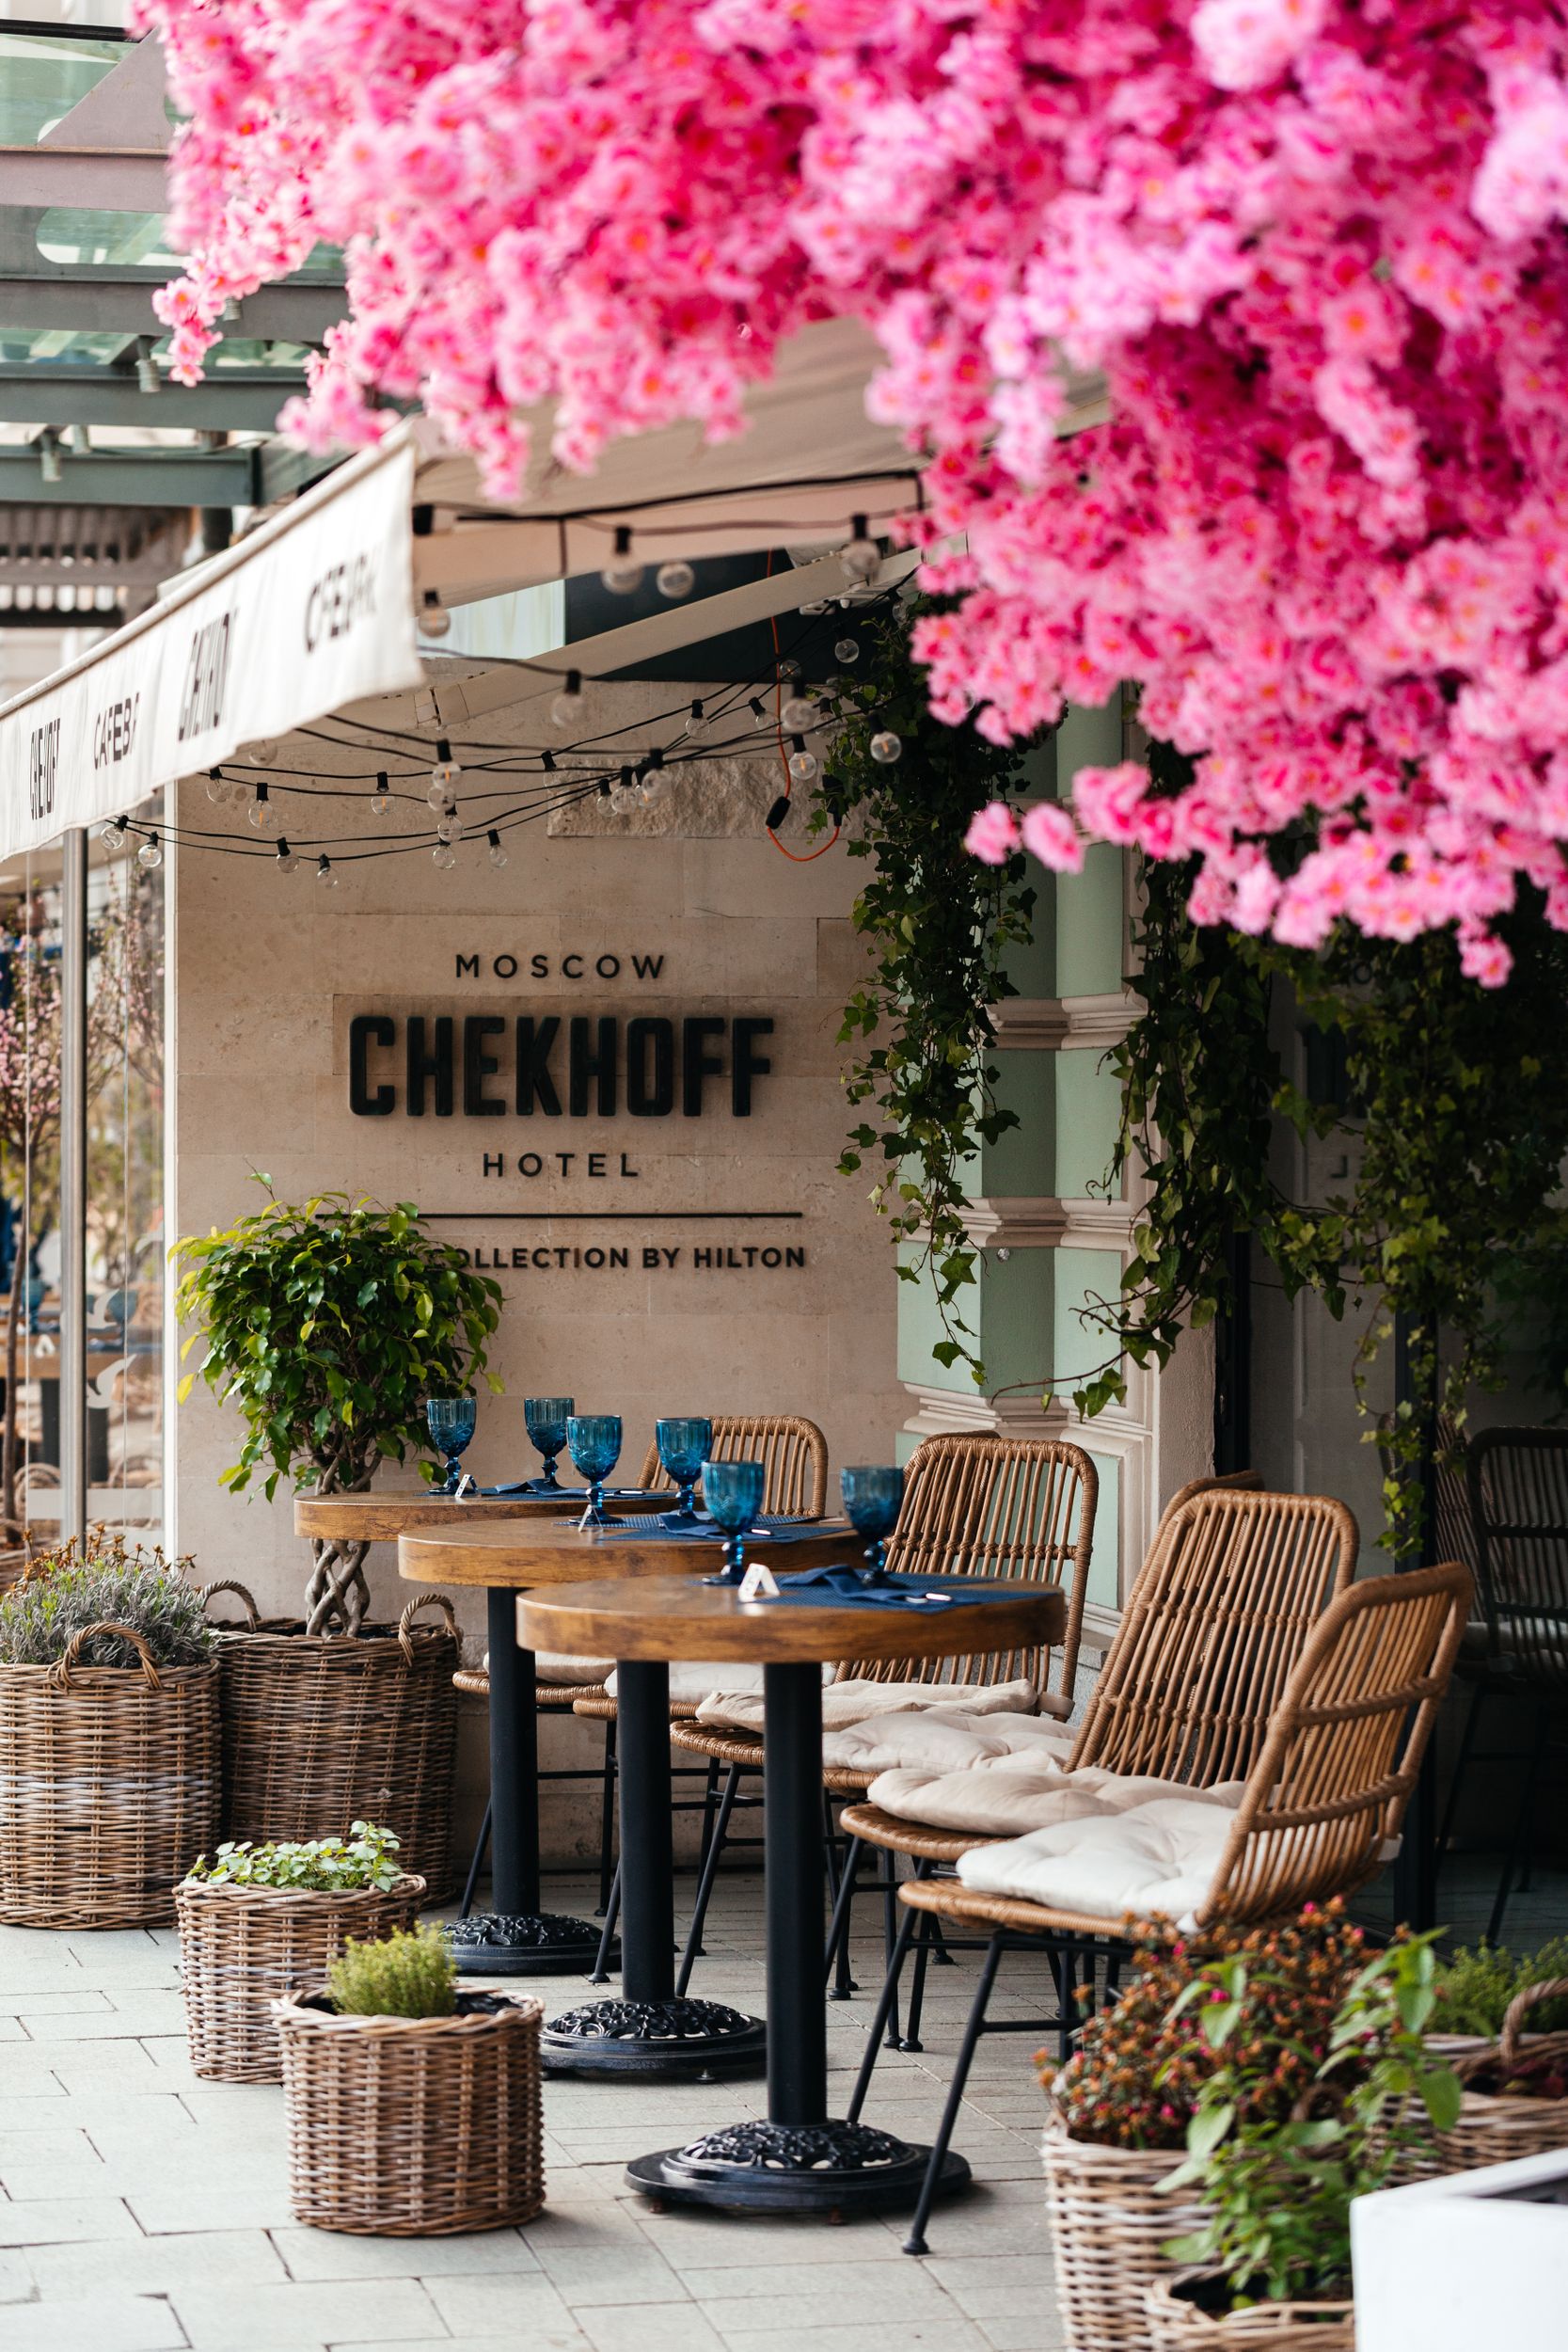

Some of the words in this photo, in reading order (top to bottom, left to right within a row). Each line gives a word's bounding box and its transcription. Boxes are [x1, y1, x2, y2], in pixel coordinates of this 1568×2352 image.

[455, 953, 664, 978] MOSCOW
[350, 1015, 774, 1117] CHEKHOFF
[483, 1152, 639, 1178] HOTEL
[641, 1247, 681, 1269] BY
[693, 1247, 806, 1269] HILTON
